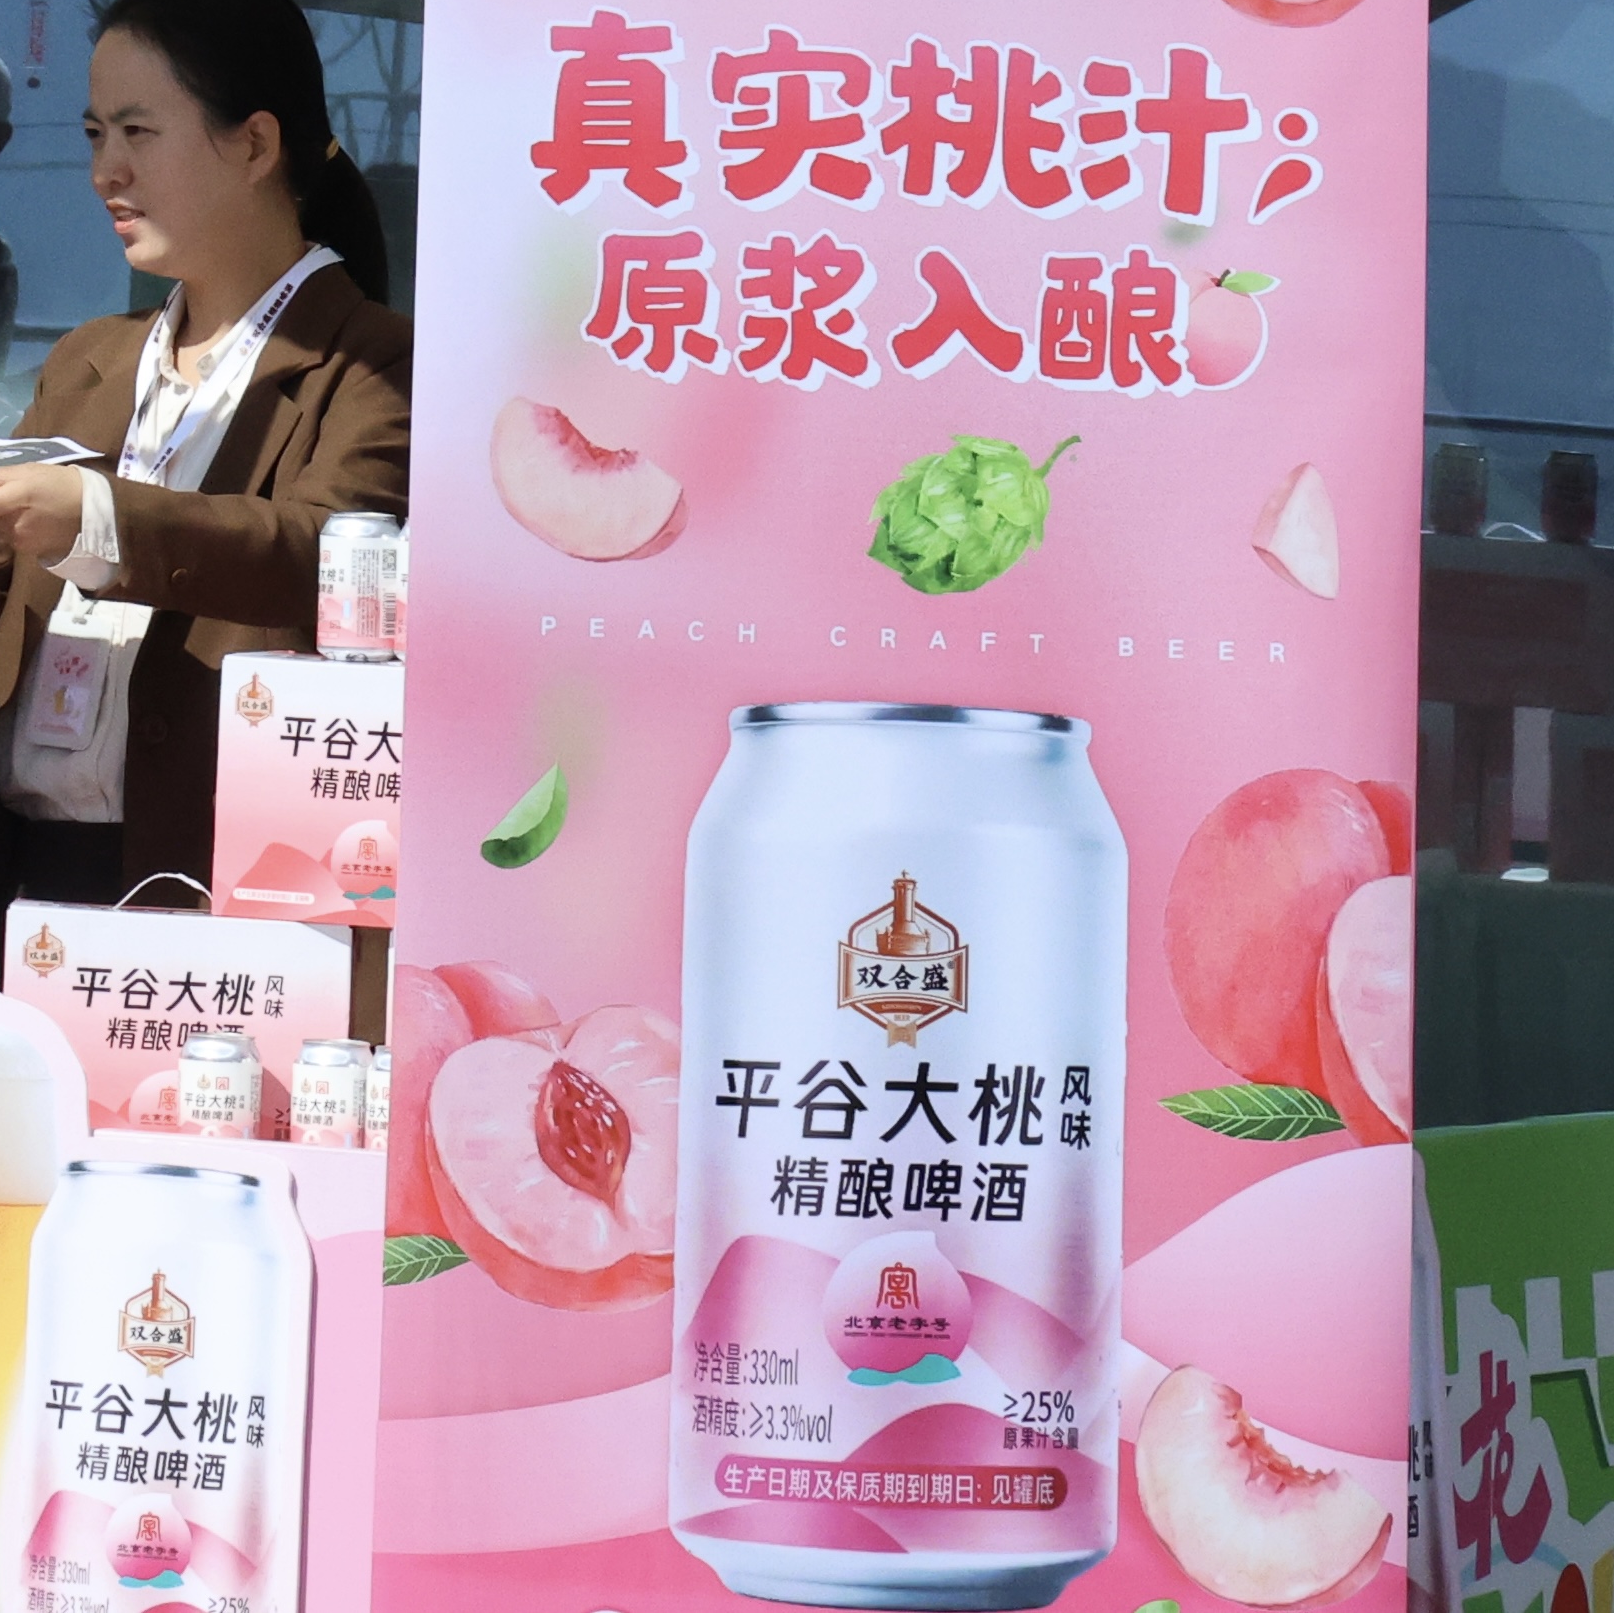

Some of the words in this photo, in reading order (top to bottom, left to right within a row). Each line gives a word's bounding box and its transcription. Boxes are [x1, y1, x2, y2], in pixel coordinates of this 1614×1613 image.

[586, 231, 1183, 389] 原浆入酿
[540, 616, 756, 644] PEACH
[829, 626, 1045, 654] CRAFT
[1119, 637, 1286, 664] BEER
[280, 716, 403, 764] 平谷大
[72, 967, 255, 1016] 平谷大桃
[855, 963, 950, 992] 双合盛
[184, 1093, 236, 1109] 平谷大桃
[716, 1059, 1046, 1147] 平谷大桃
[1060, 1066, 1092, 1151] 风味
[770, 1156, 1029, 1223] 精酿啤酒
[844, 1316, 951, 1333] 北京老字号
[46, 1379, 238, 1444] 平谷大桃
[246, 1396, 266, 1448] 风味
[1002, 1426, 1079, 1451] 原果汁含量
[76, 1442, 227, 1491] 精酿啤酒
